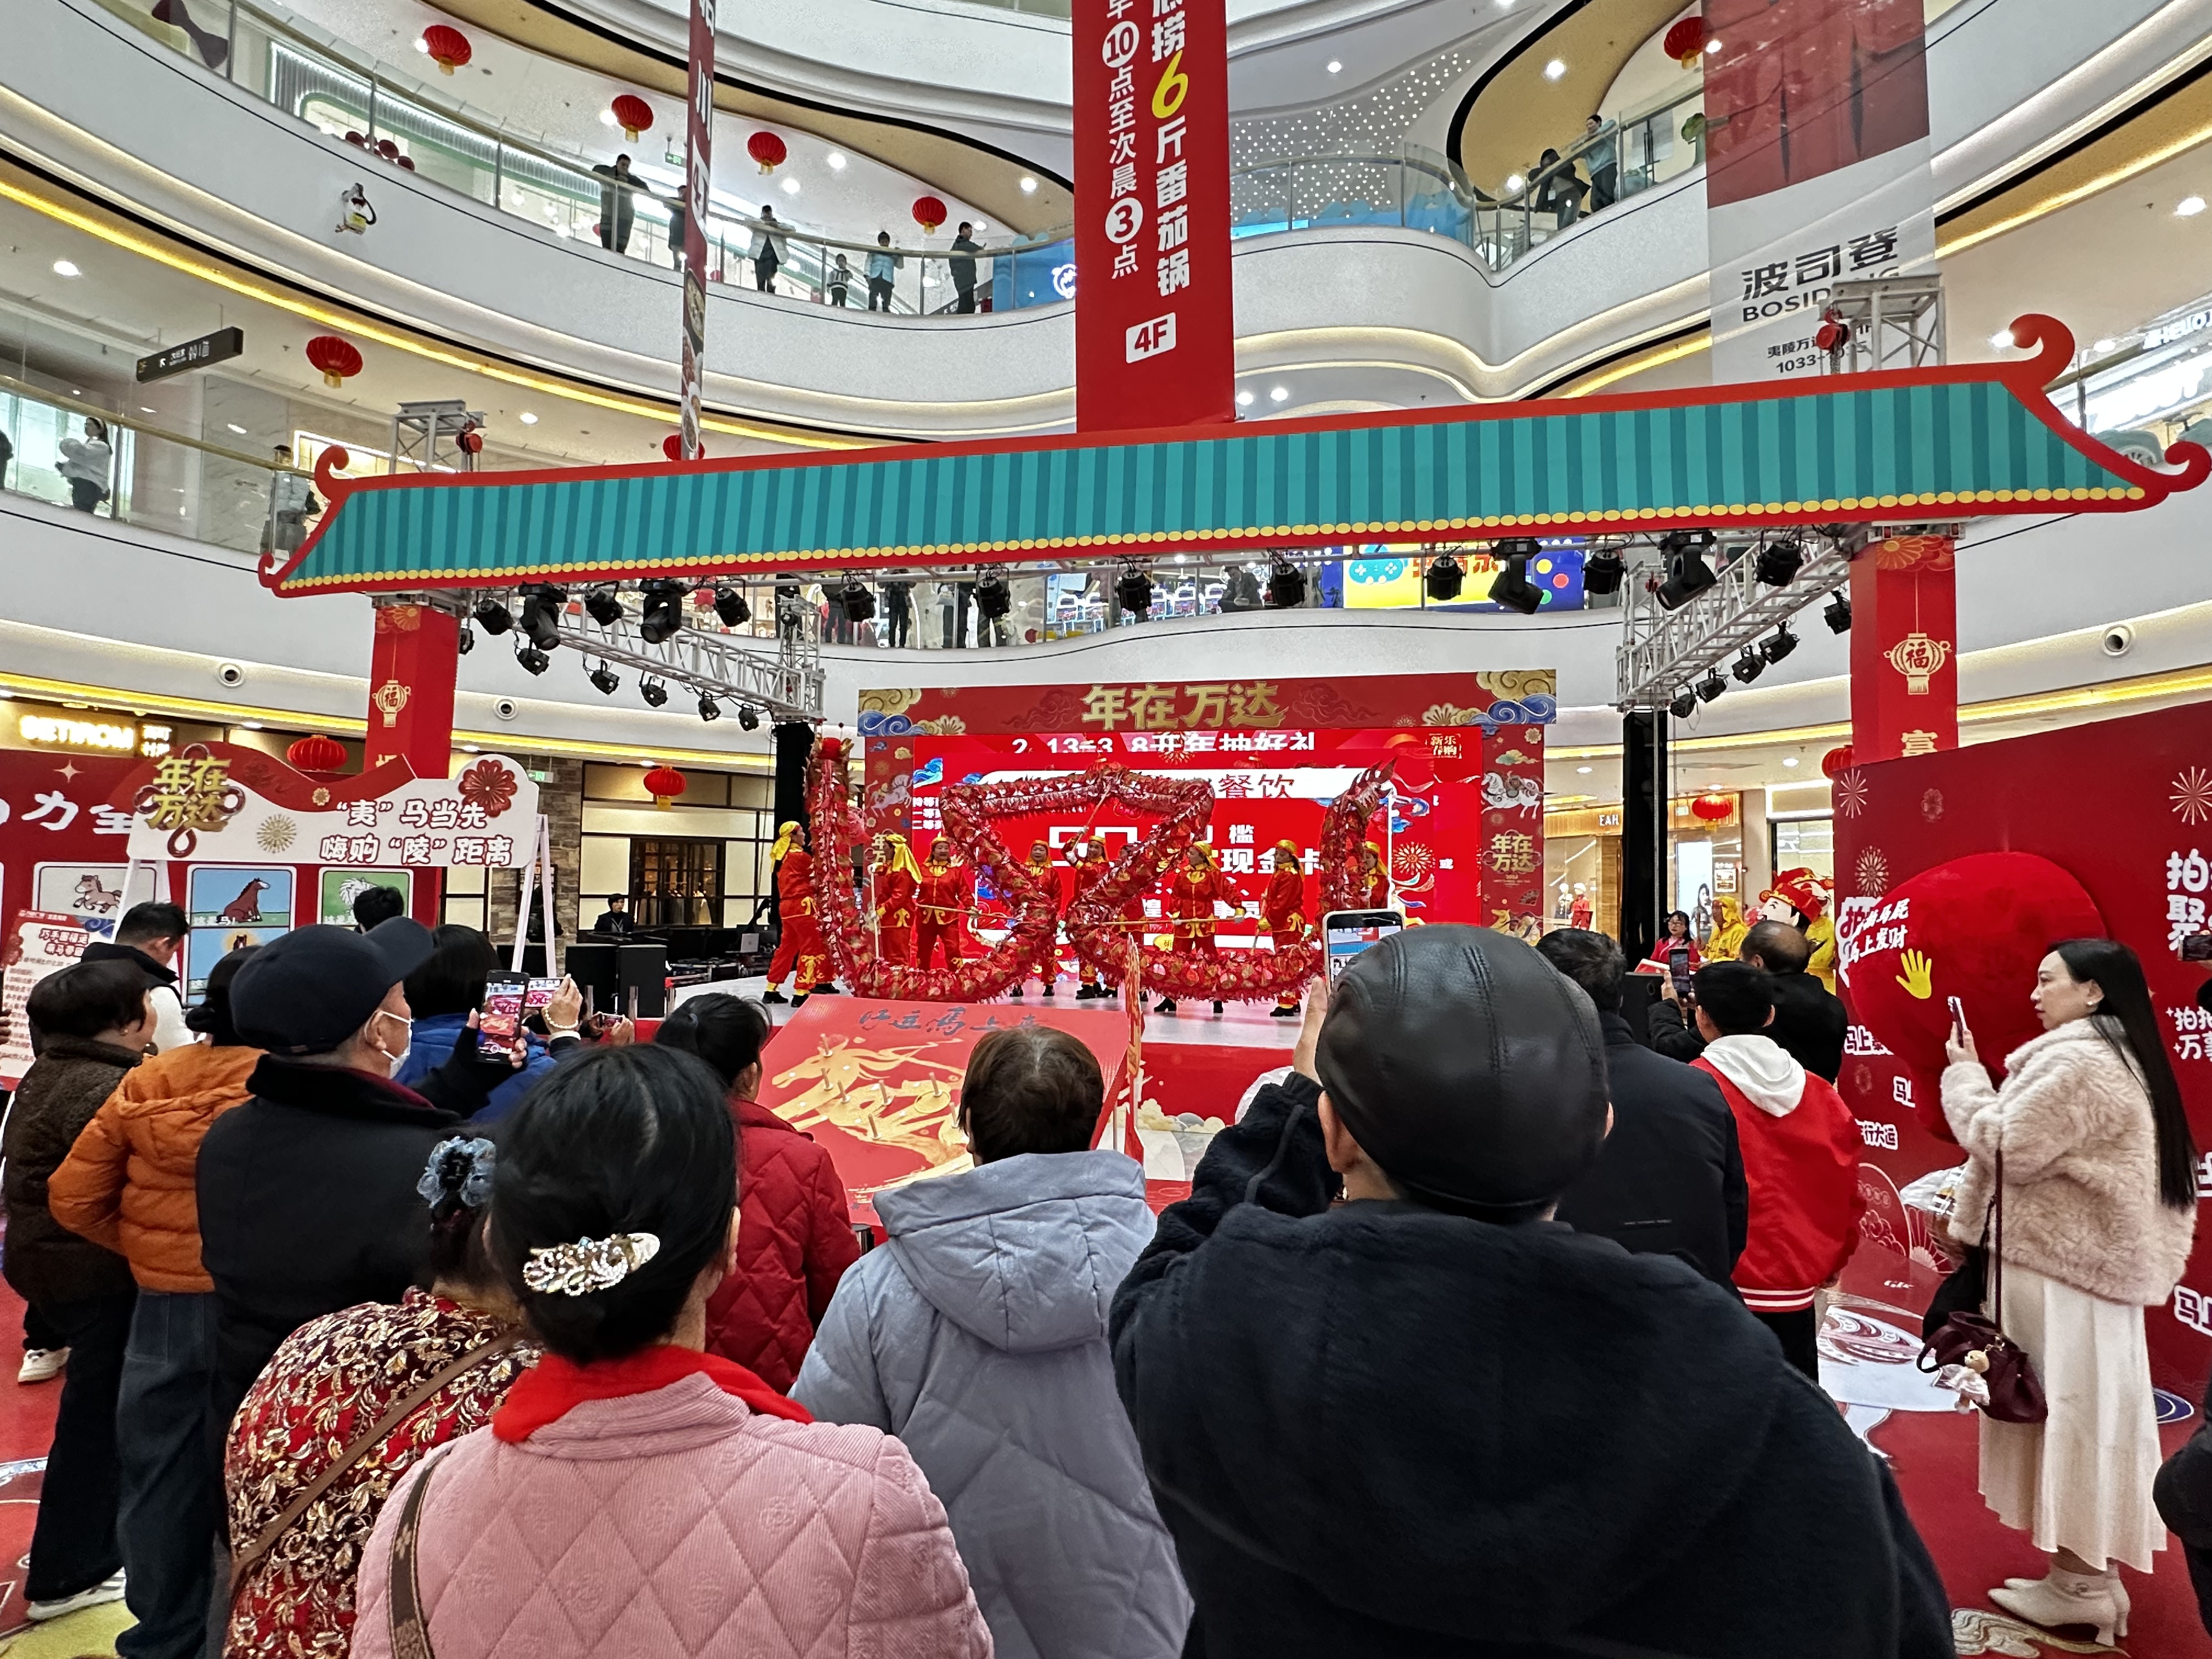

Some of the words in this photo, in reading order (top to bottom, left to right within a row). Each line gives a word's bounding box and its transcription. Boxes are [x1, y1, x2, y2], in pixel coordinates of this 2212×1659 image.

[1741, 226, 1898, 301] 波司登
[1134, 318, 1169, 353] 4F
[1905, 641, 1930, 669] 福
[384, 687, 398, 707] 福
[1080, 681, 1289, 730] 年在万达
[153, 755, 232, 793] 年在
[144, 793, 229, 832] 万达
[1491, 833, 1533, 853] 年在
[1491, 853, 1536, 873] 万达
[2166, 848, 2212, 892] 拍
